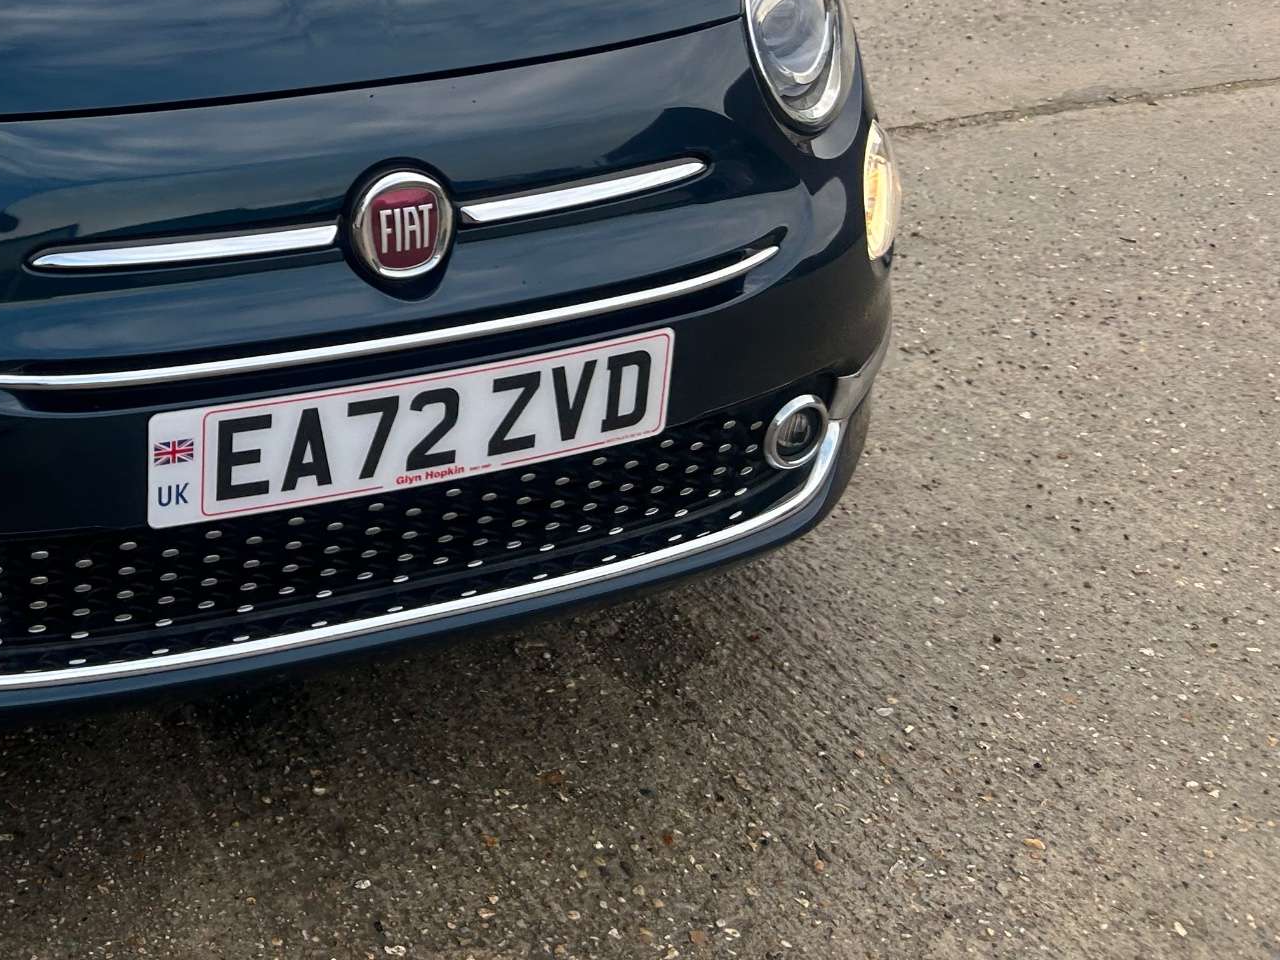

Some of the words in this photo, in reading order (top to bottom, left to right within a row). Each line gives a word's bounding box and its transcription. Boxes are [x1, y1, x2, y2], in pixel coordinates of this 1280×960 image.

[379, 203, 433, 254] FIAT
[216, 386, 460, 501] EA72
[487, 349, 652, 456] ZVD
[396, 475, 422, 485] Glyn
[425, 465, 465, 480] Hopkin
[157, 482, 189, 507] UK
